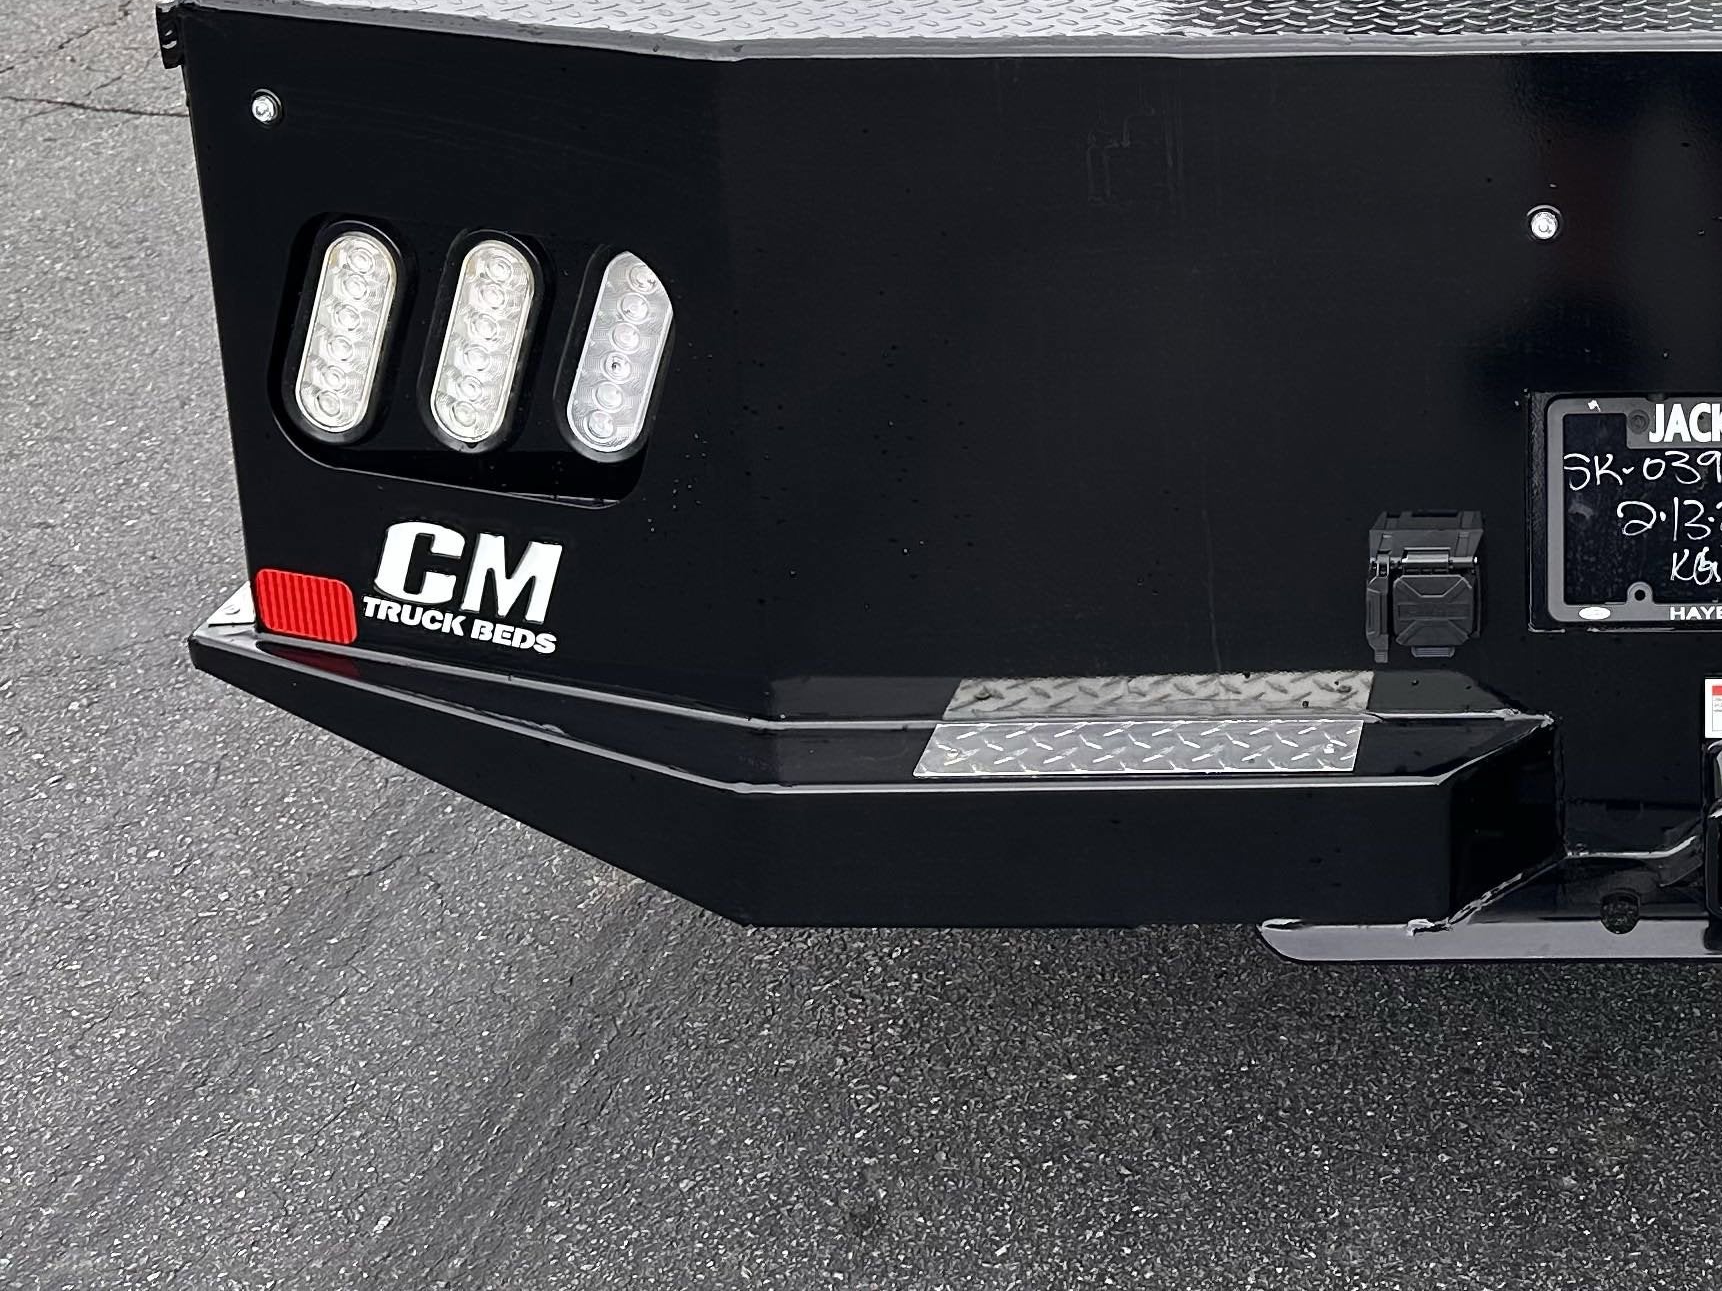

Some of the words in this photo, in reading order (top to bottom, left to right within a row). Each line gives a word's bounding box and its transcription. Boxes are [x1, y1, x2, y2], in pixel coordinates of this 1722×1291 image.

[374, 521, 563, 624] CM
[363, 596, 467, 636] TRUCK
[470, 618, 557, 654] BEDS
